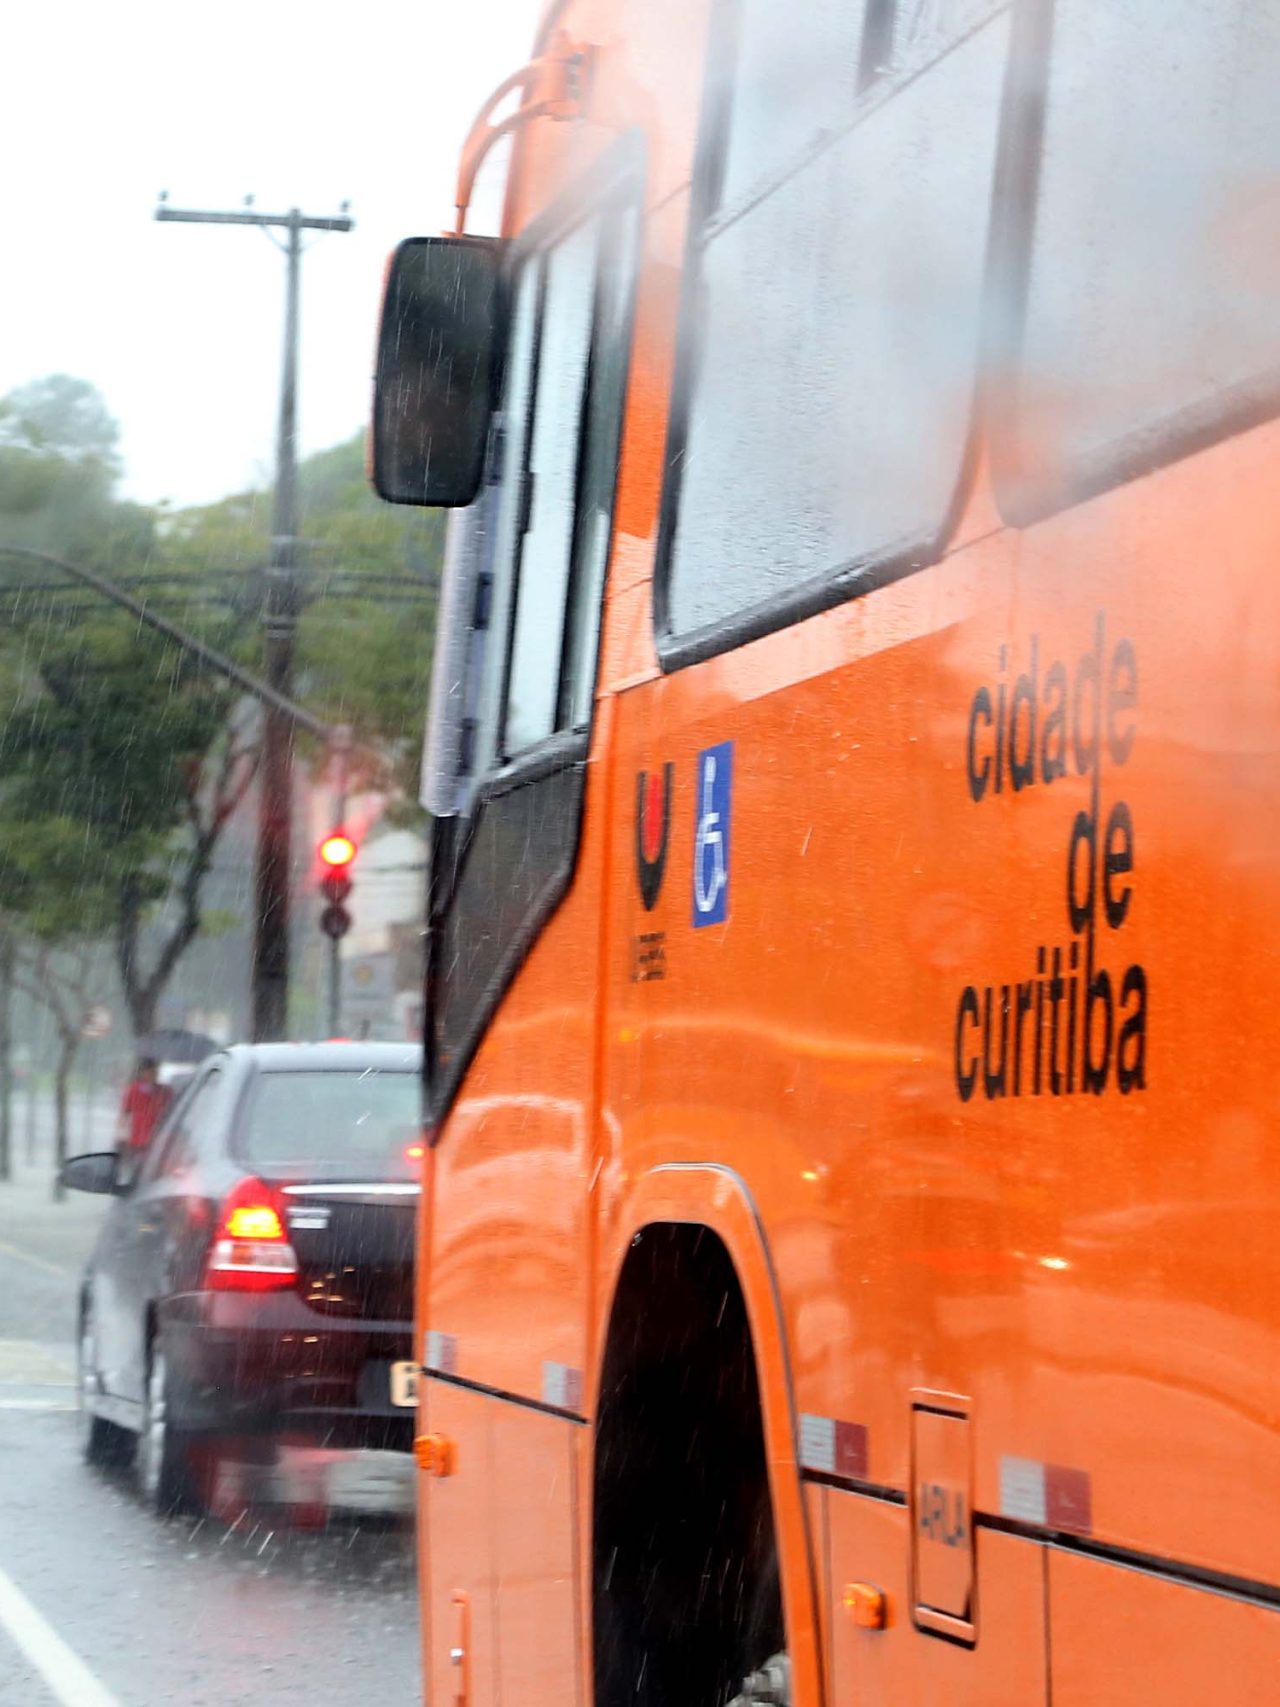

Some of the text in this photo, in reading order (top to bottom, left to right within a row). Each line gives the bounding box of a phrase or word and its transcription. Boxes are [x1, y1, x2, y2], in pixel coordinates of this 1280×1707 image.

[966, 607, 1138, 803] cidade
[1067, 790, 1133, 935] de
[955, 938, 1147, 1102] curitiba
